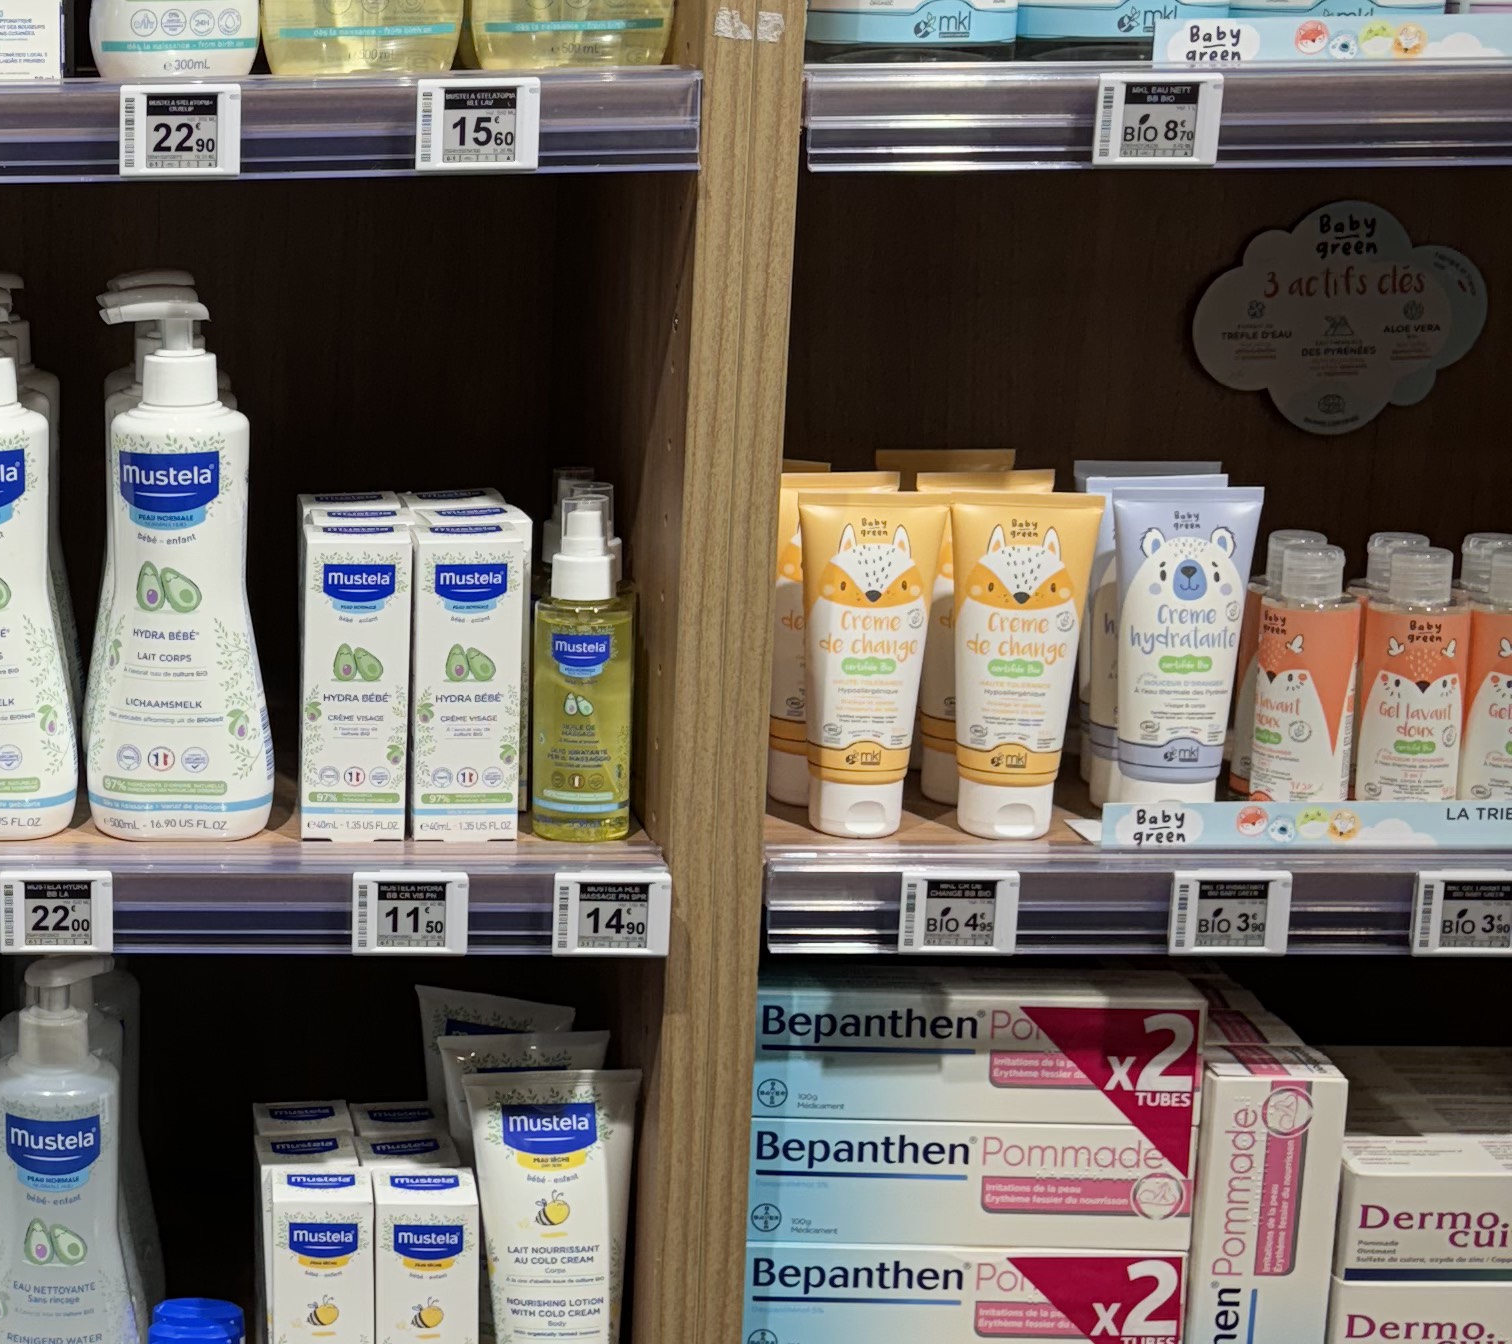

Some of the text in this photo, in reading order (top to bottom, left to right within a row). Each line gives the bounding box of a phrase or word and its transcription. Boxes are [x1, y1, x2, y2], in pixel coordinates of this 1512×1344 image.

[939, 11, 971, 32] mkl
[1189, 24, 1242, 46] Baby
[1130, 623, 1236, 653] hydratante
[819, 637, 918, 661] de change
[1397, 723, 1434, 737] doux
[1136, 809, 1185, 828] Baby
[1133, 829, 1186, 846] green
[761, 1004, 978, 1043] Bepanthen
[1137, 1092, 1190, 1108] TUBES
[509, 1115, 589, 1132] Mustela
[756, 1131, 1163, 1170] Bepanthen Pommade
[561, 1256, 594, 1264] CREAM
[752, 1257, 963, 1293] Bepanthen
